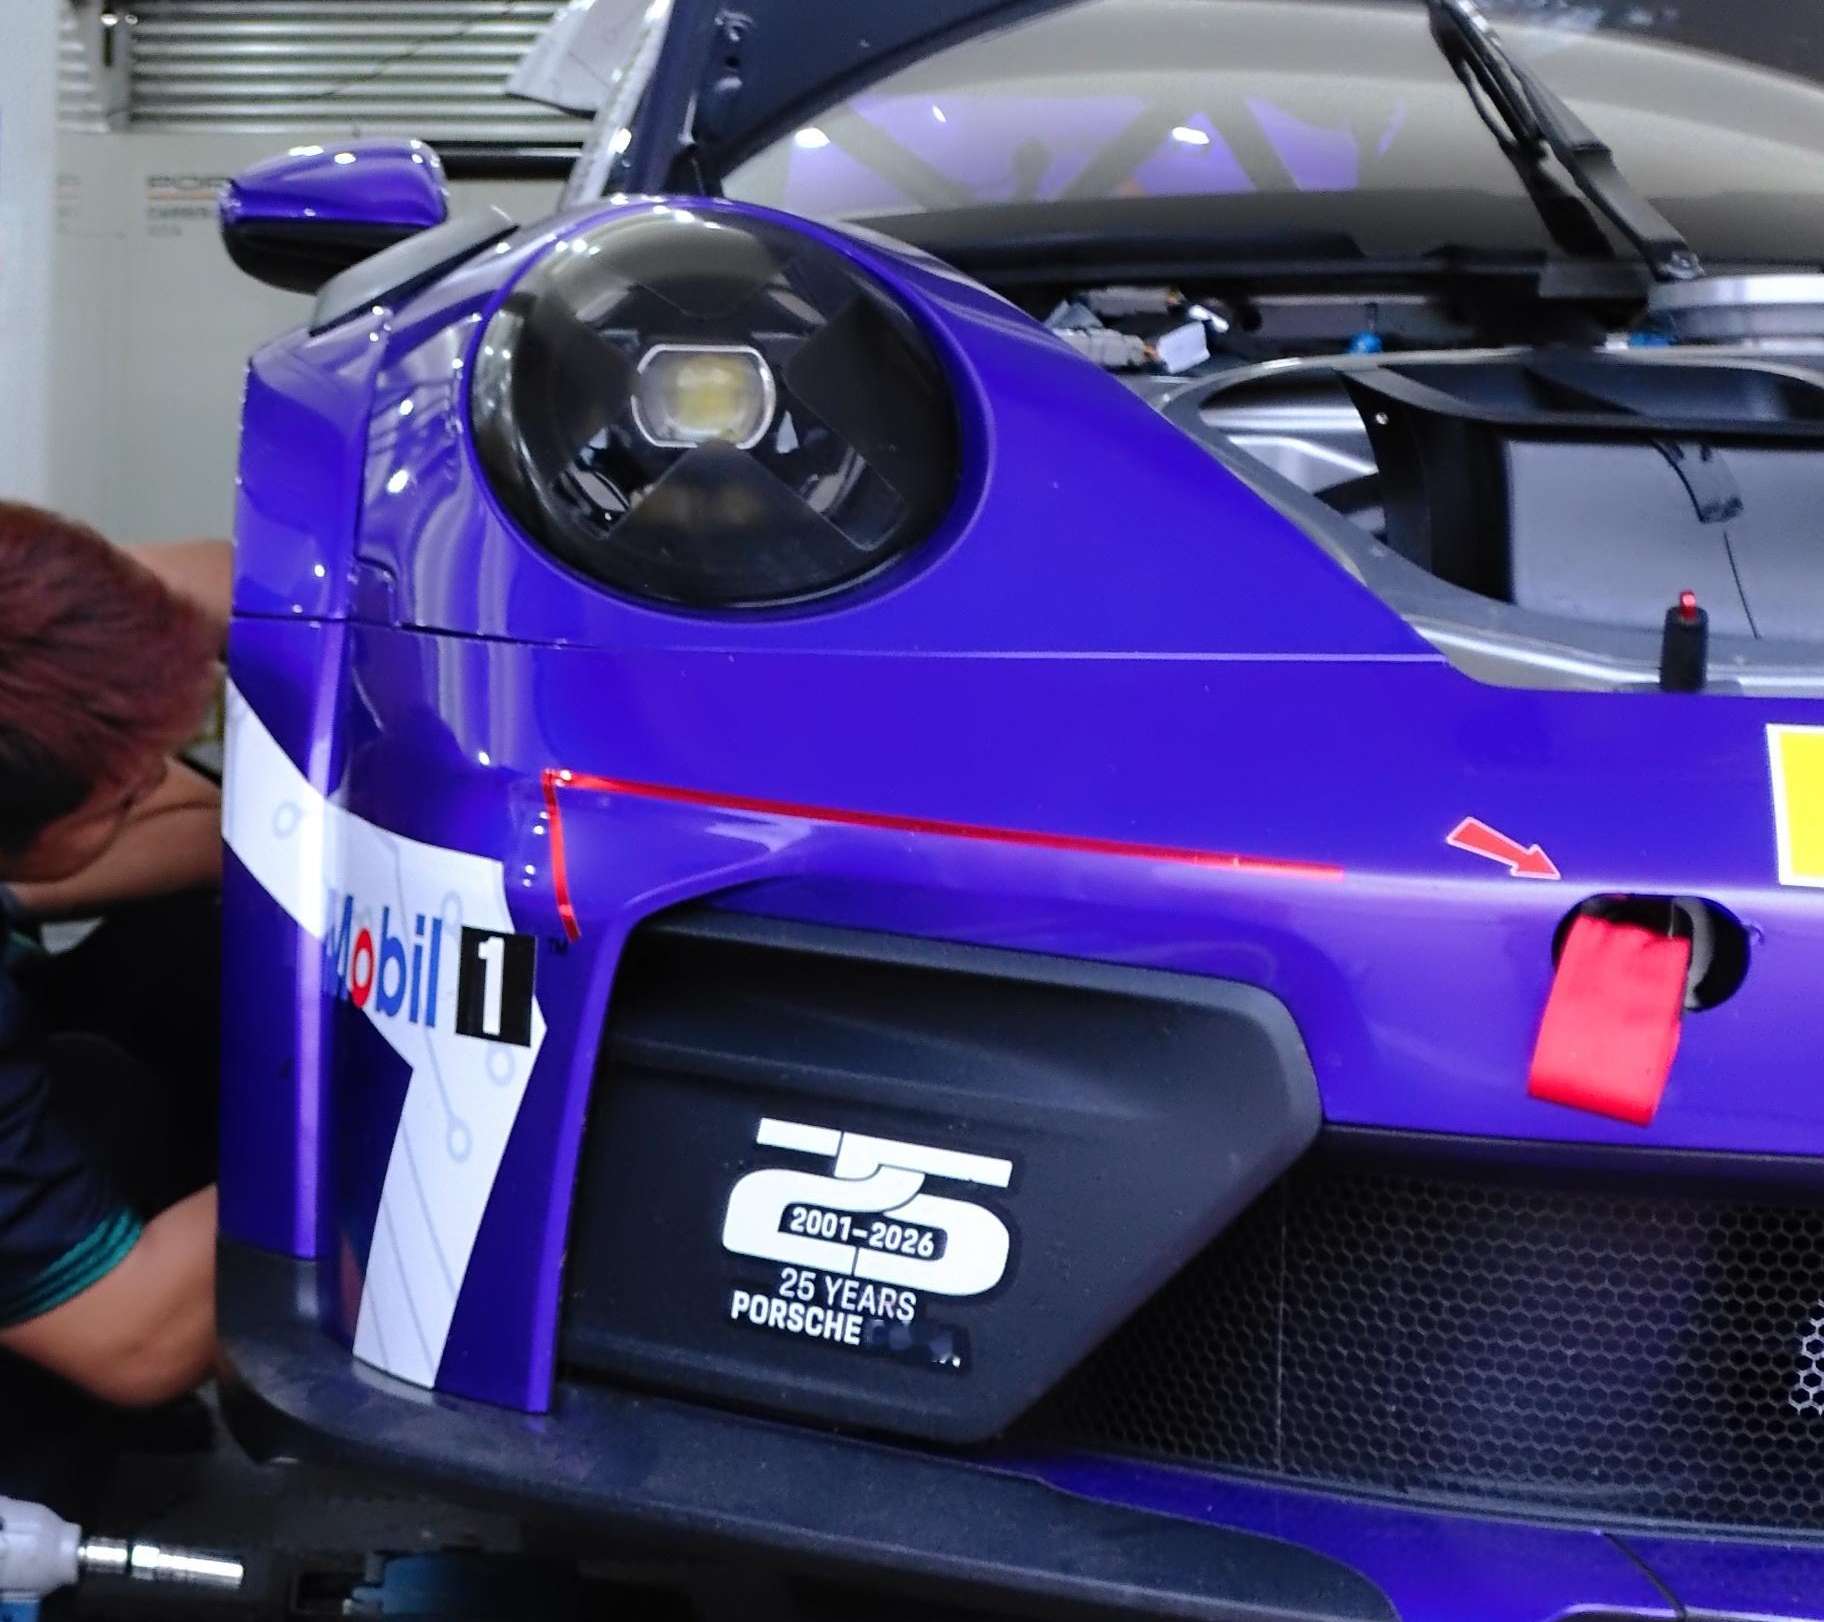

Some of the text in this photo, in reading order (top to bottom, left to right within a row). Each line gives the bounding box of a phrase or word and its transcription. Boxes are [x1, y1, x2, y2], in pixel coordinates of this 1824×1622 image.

[323, 890, 443, 1029] Mobil
[789, 1206, 935, 1258] 2001-2026
[730, 1289, 864, 1346] PORSCHE
[778, 1267, 917, 1323] 25 YEARS
